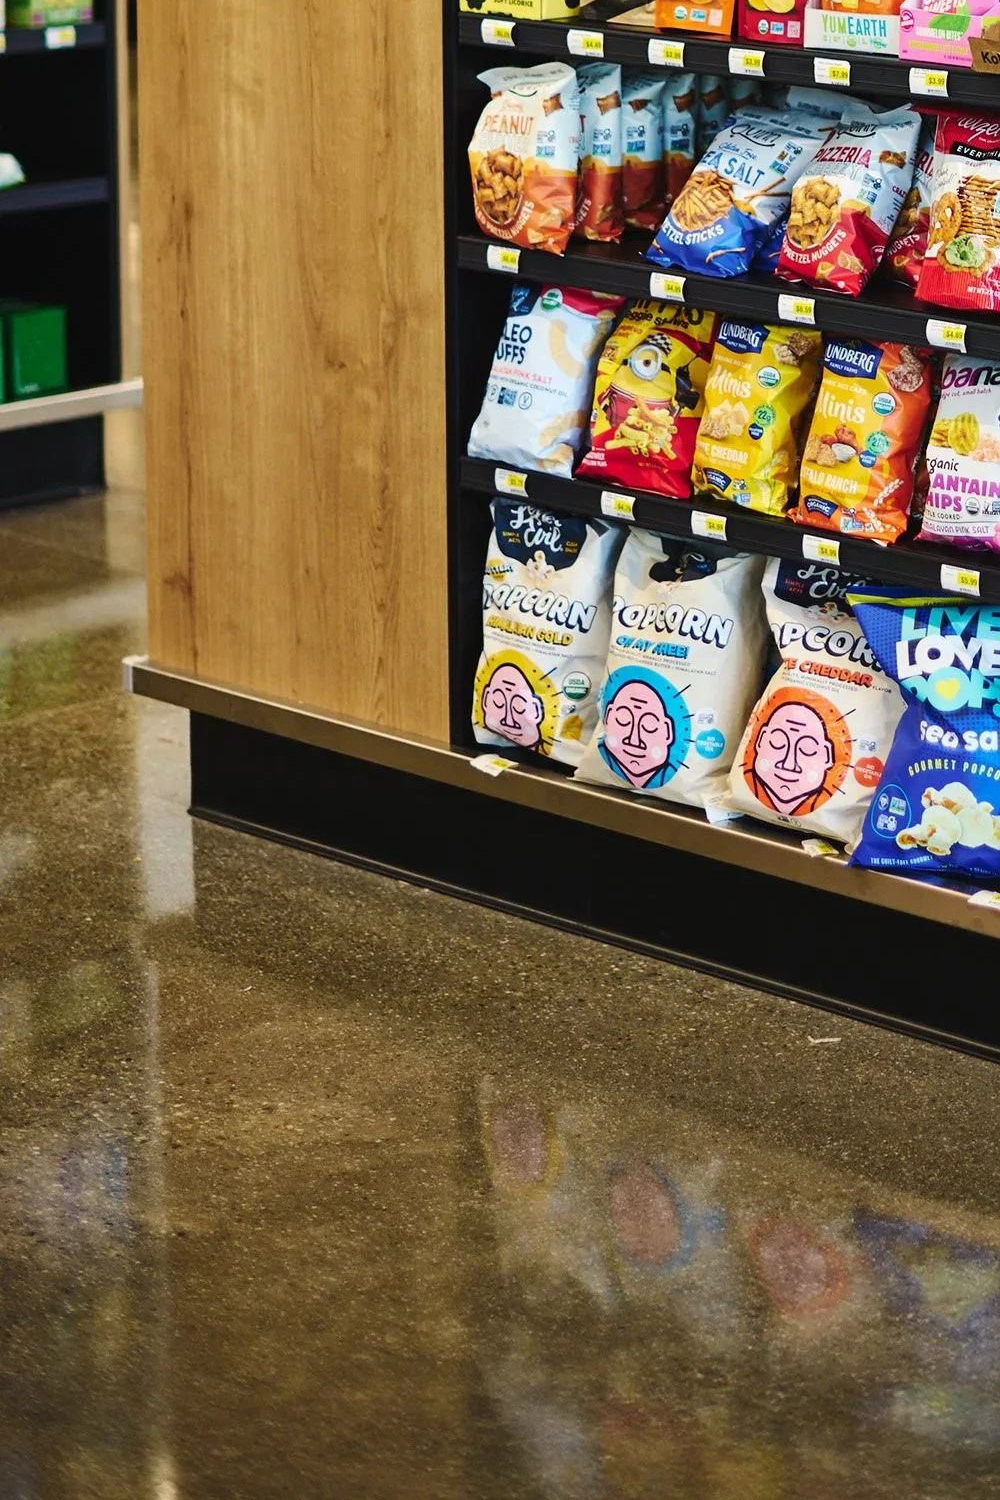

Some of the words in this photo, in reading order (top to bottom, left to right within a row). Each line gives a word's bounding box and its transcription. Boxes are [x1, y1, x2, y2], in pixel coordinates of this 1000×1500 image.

[822, 14, 887, 38] YUMEARTH
[666, 51, 681, 59] $3.99
[483, 115, 534, 134] PEANUT
[814, 145, 871, 169] PIZZERIA
[723, 158, 766, 188] SALT
[685, 224, 724, 246] STICKS
[718, 321, 760, 347] LUNDBERG
[705, 367, 751, 400] Minis
[826, 474, 858, 494] RANCH
[484, 582, 597, 633] POPCORN
[536, 629, 573, 647] GOLD
[800, 660, 873, 687] CHEDDAR
[920, 720, 958, 749] sea
[908, 759, 956, 776] GOURMET
